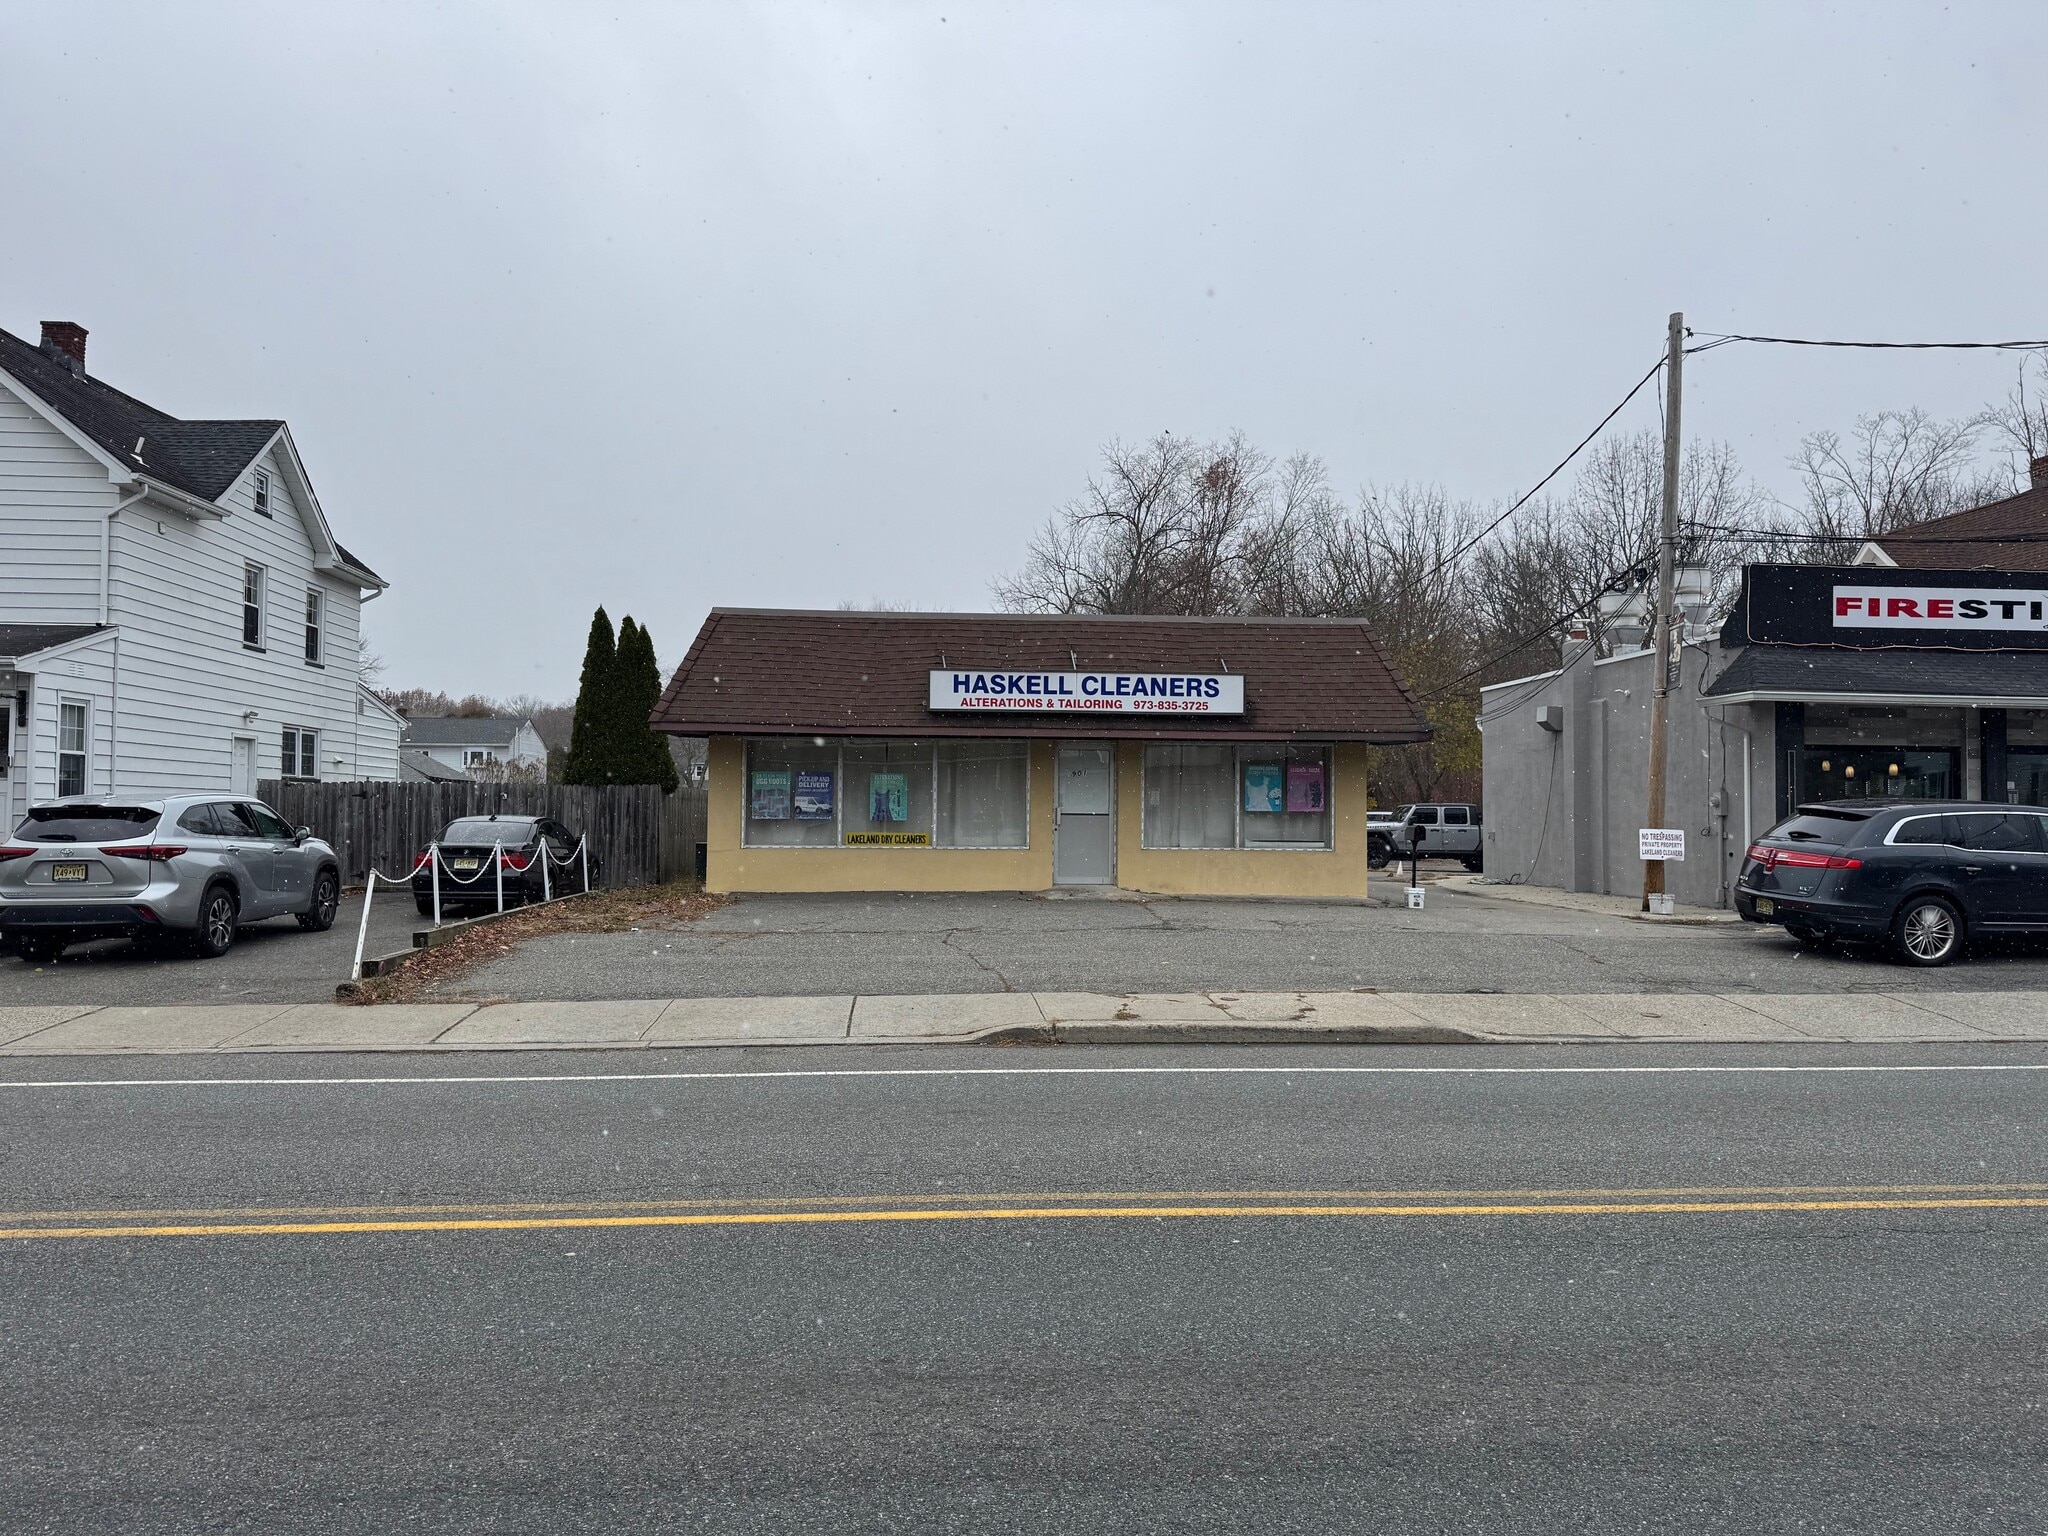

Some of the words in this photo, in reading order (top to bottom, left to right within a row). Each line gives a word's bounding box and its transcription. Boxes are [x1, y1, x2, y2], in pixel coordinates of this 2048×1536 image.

[953, 674, 1073, 695] HASKELL
[1081, 675, 1220, 698] CLEANERS
[960, 697, 1043, 709] ALTERATIONS
[1046, 698, 1055, 709] &
[1058, 698, 1123, 710] TAILORING
[1133, 700, 1209, 711] 973-835-3725
[847, 834, 880, 844] LAKELAND
[881, 835, 894, 844] DRY
[894, 835, 926, 844] CLEANERS
[1650, 833, 1682, 841] TRESPASSING
